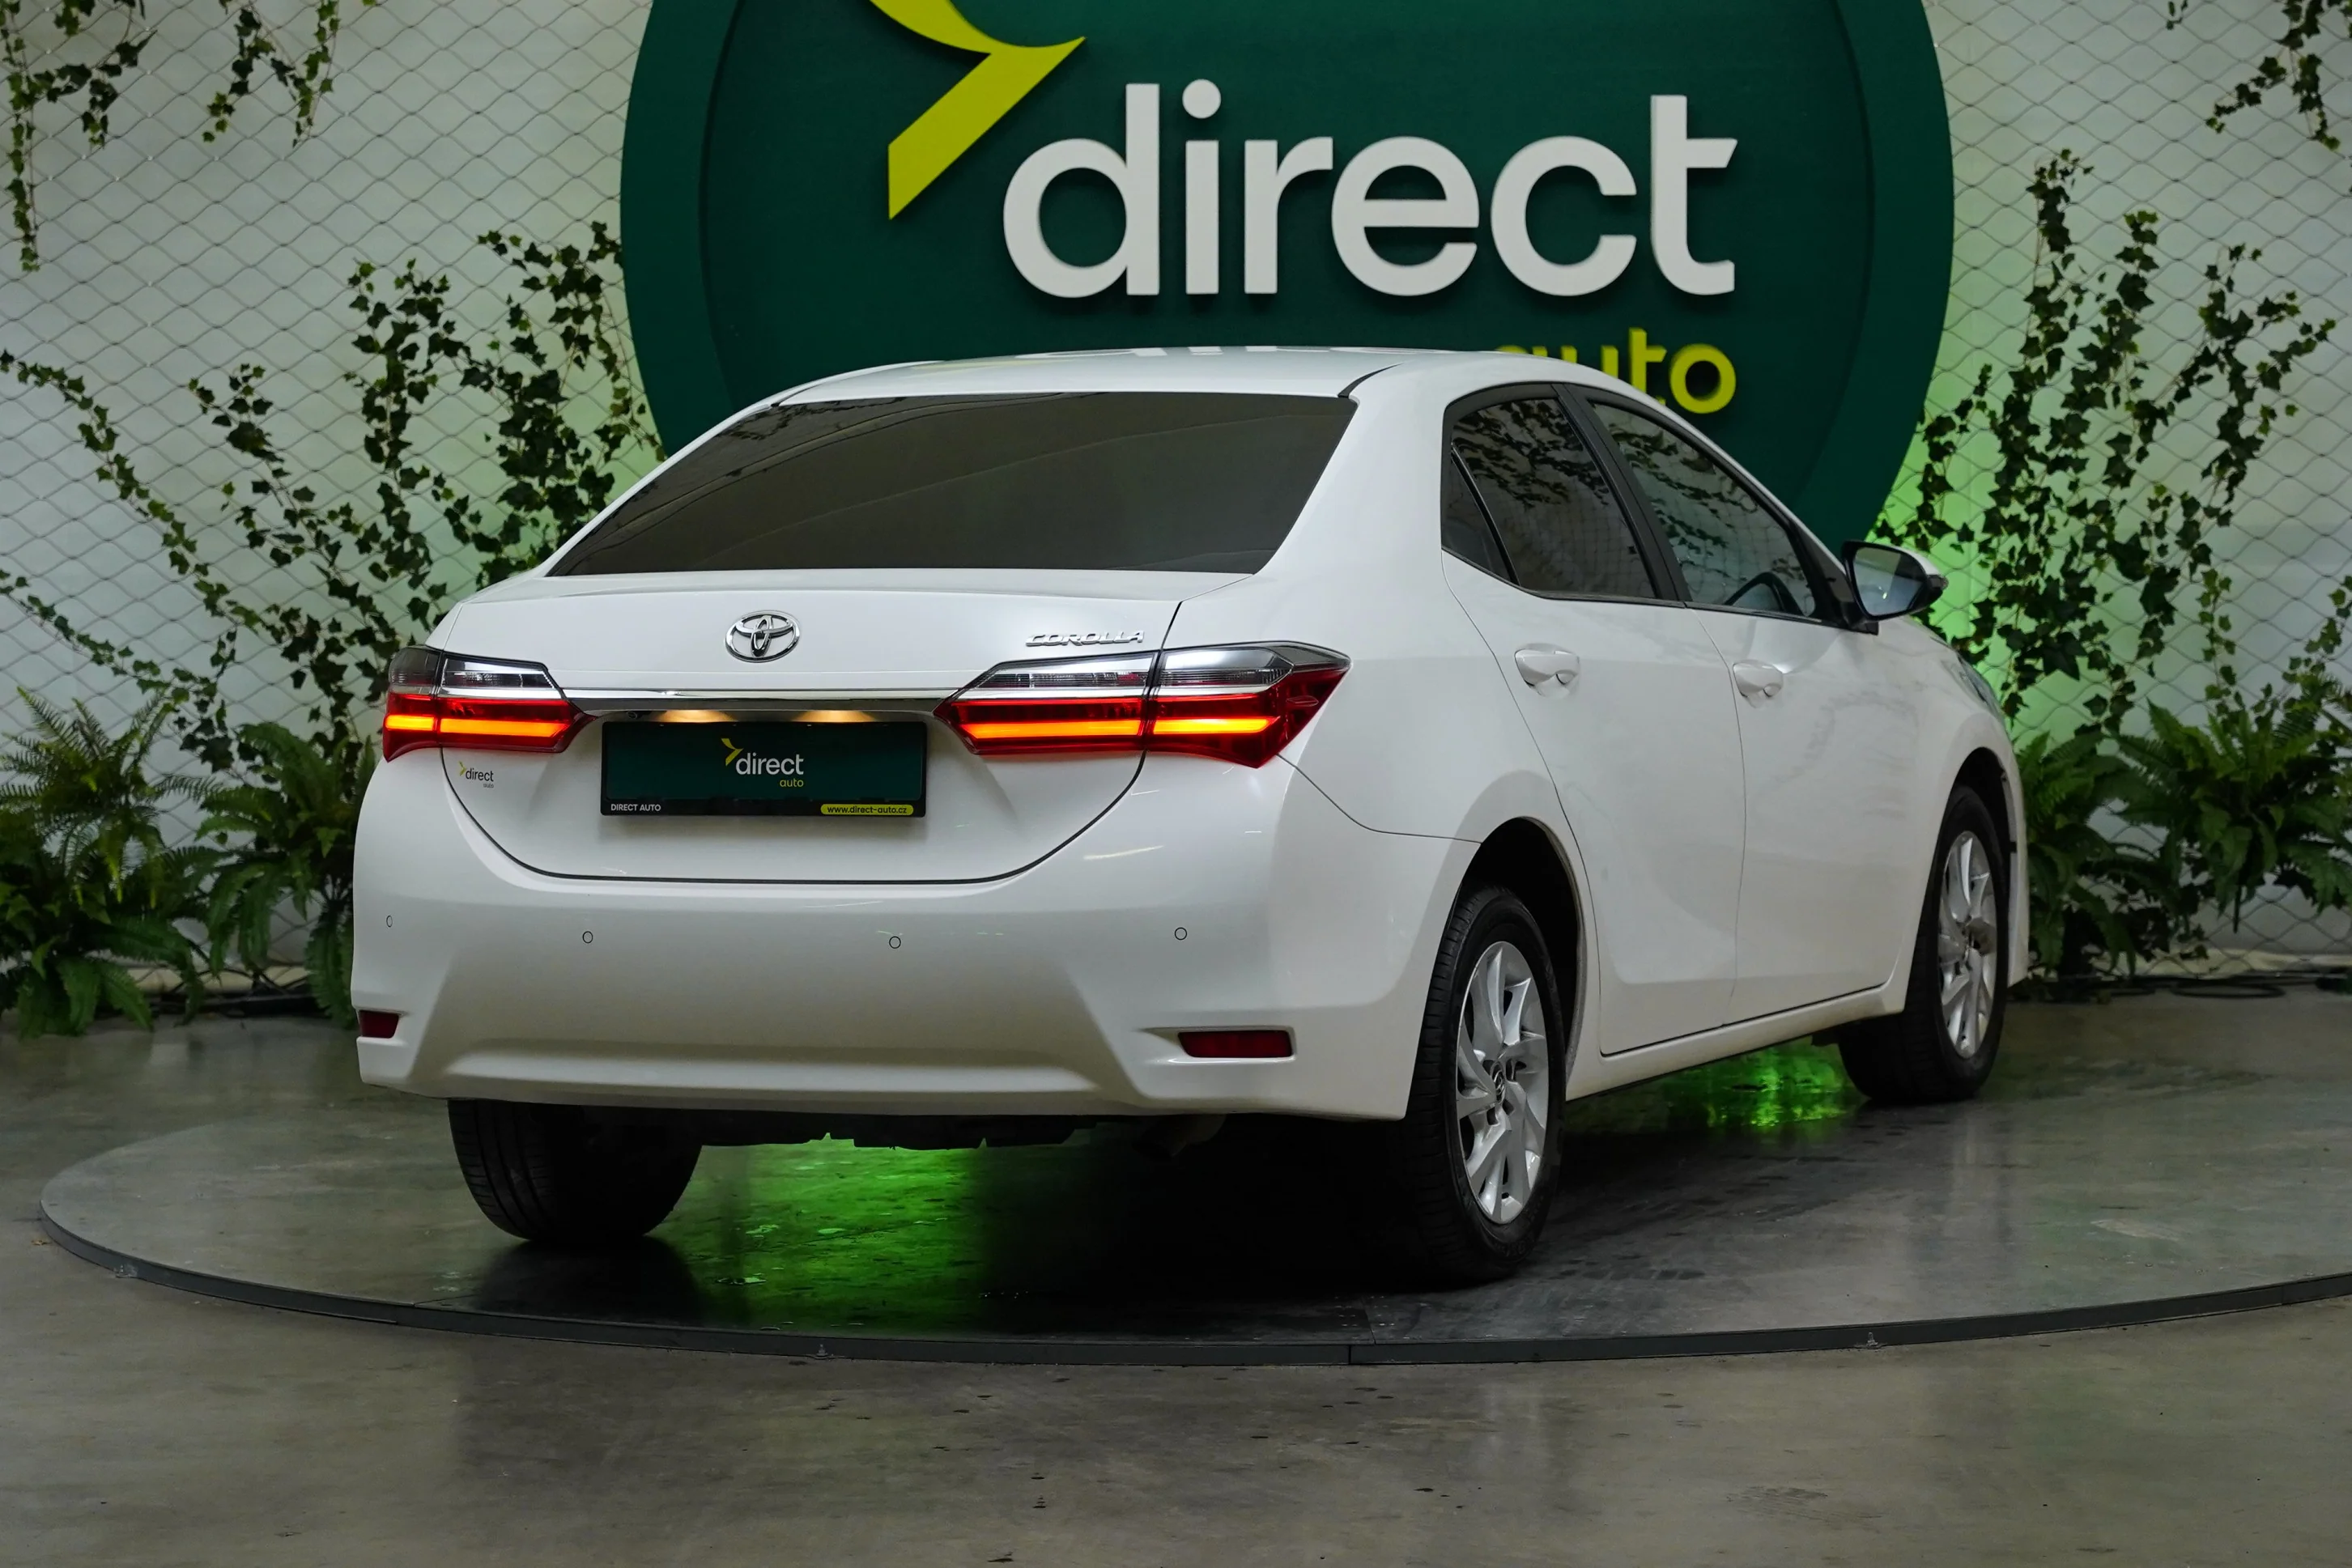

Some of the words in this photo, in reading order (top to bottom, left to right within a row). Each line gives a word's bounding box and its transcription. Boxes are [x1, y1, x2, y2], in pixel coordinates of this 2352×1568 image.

[1003, 79, 1737, 298] direct
[1026, 631, 1144, 647] COROLLA
[735, 752, 804, 776] direct
[466, 768, 494, 782] direct
[780, 778, 804, 788] auto
[610, 803, 638, 812] DIRECT
[640, 803, 661, 812] AUTO
[827, 805, 908, 814] www.direct-auto.cz
